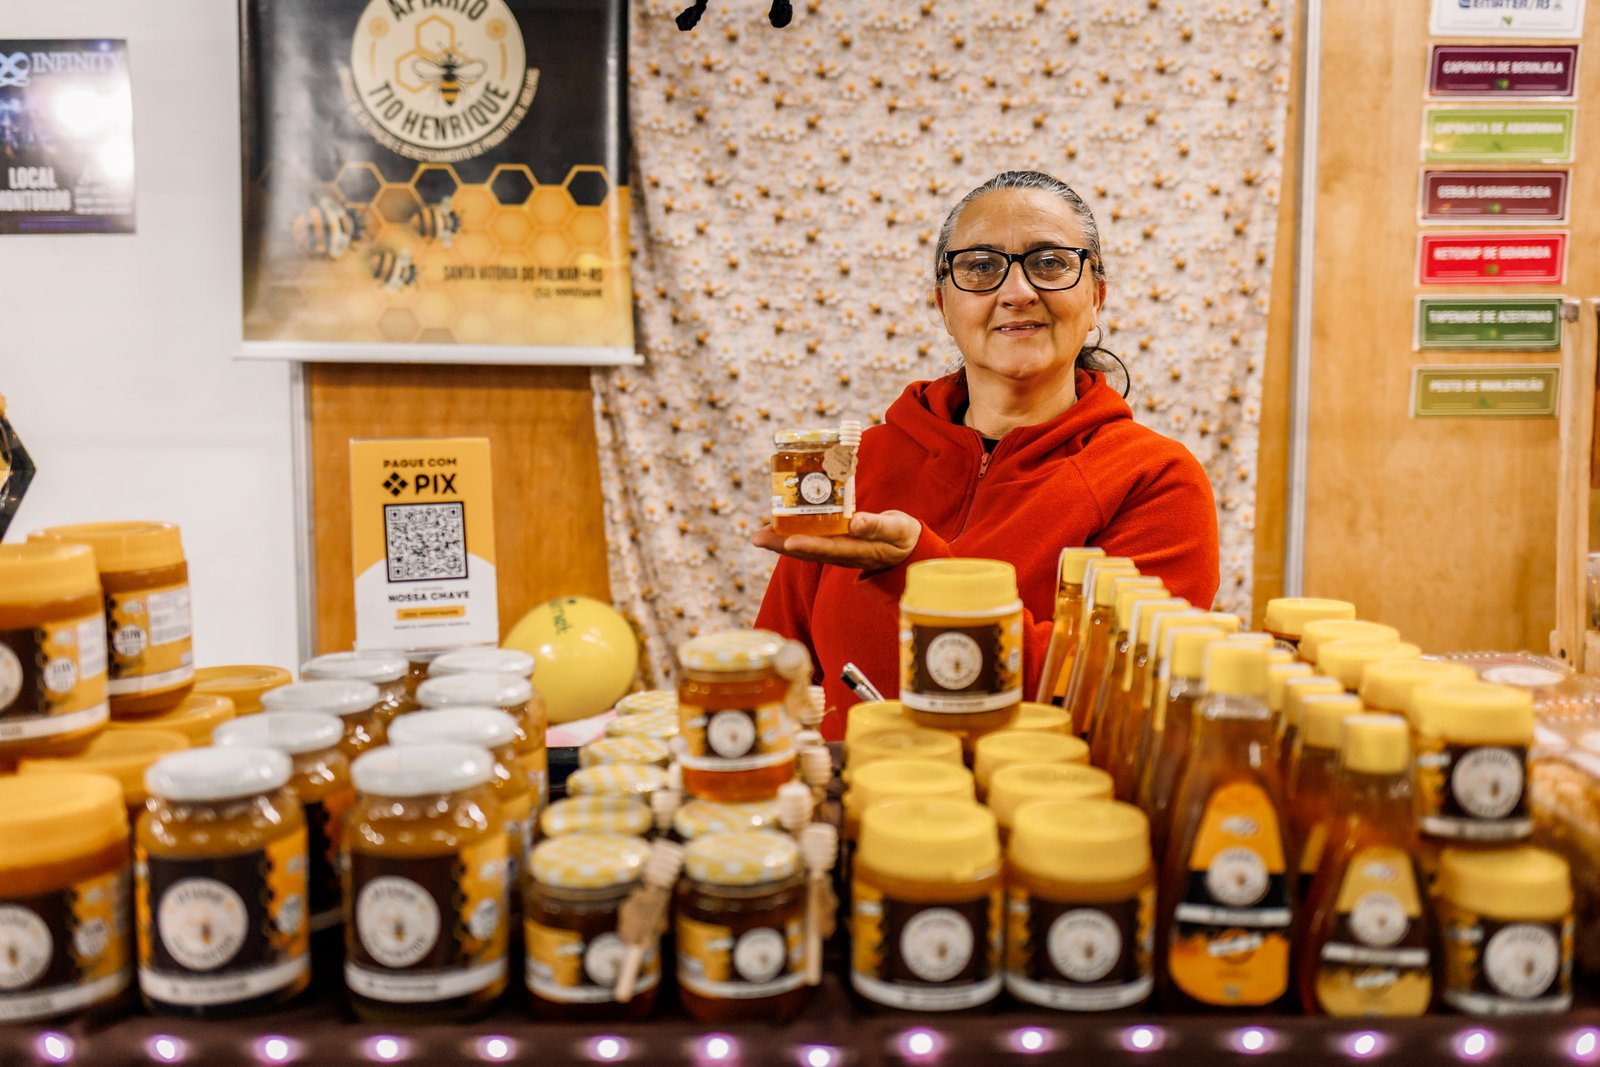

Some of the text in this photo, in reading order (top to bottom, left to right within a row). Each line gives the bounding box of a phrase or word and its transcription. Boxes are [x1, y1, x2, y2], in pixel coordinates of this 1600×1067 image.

[32, 51, 122, 74] INFINITY
[1496, 60, 1511, 74] DE
[369, 81, 404, 121] TIO
[401, 82, 510, 141] HENRIQUE
[1490, 121, 1505, 135] DE
[8, 166, 58, 189] LOCAL
[1481, 246, 1498, 260] DE
[1481, 309, 1497, 324] DE
[1464, 378, 1478, 393] DE
[383, 458, 457, 468] PAGUE COM
[415, 473, 457, 495] PIX
[388, 590, 470, 602] NOSSA CHAVE
